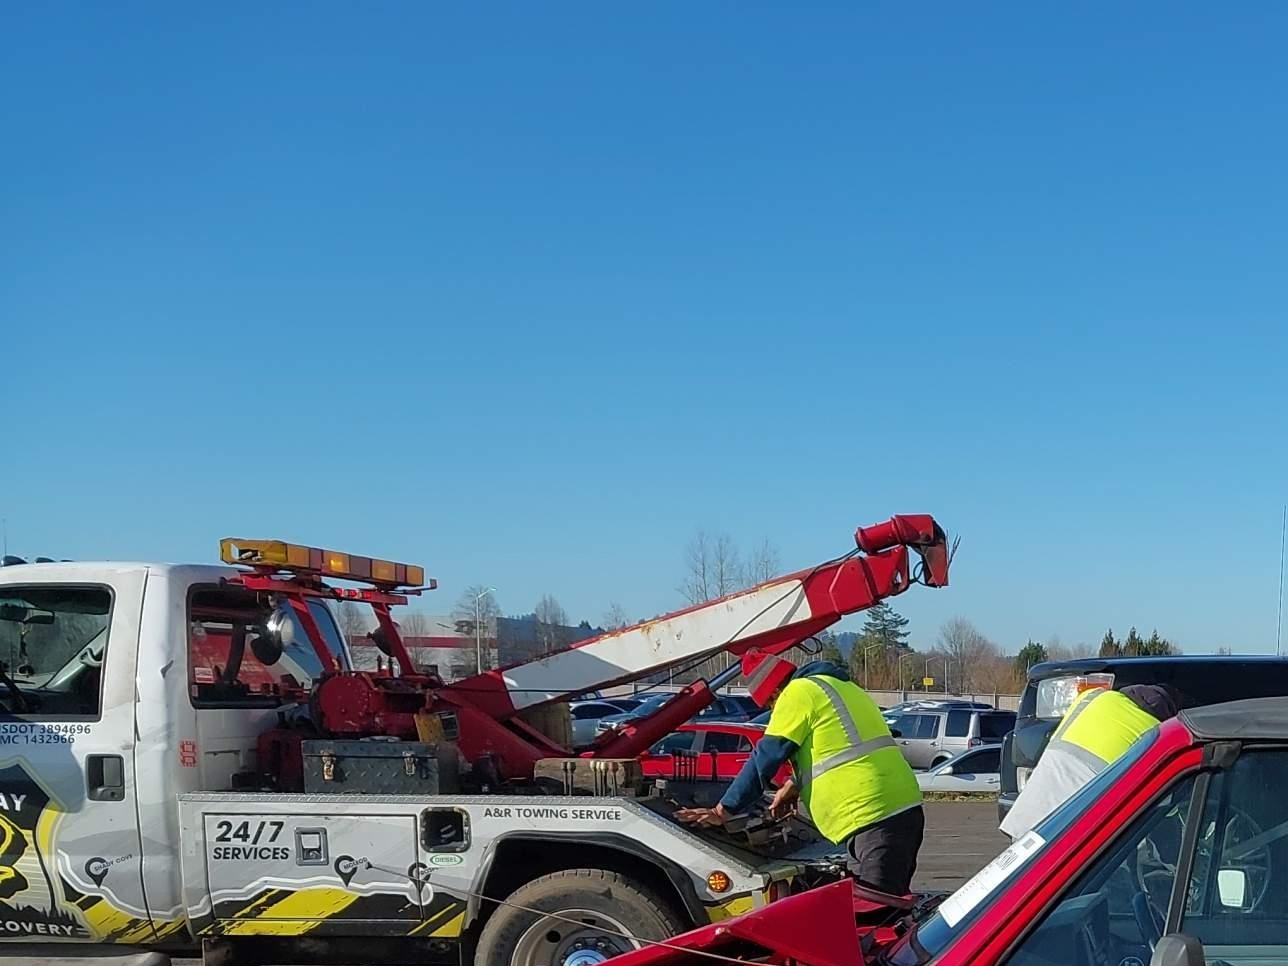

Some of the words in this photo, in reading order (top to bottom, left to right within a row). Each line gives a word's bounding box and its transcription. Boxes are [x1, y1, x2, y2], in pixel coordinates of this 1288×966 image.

[0, 724, 35, 734] SDOT
[40, 724, 91, 734] 3894696
[23, 734, 75, 744] 1432966
[484, 808, 512, 818] A&R
[515, 808, 568, 819] TOWING
[571, 809, 622, 820] SERVICE
[216, 820, 284, 845] 24/7
[213, 847, 290, 860] SERVICES
